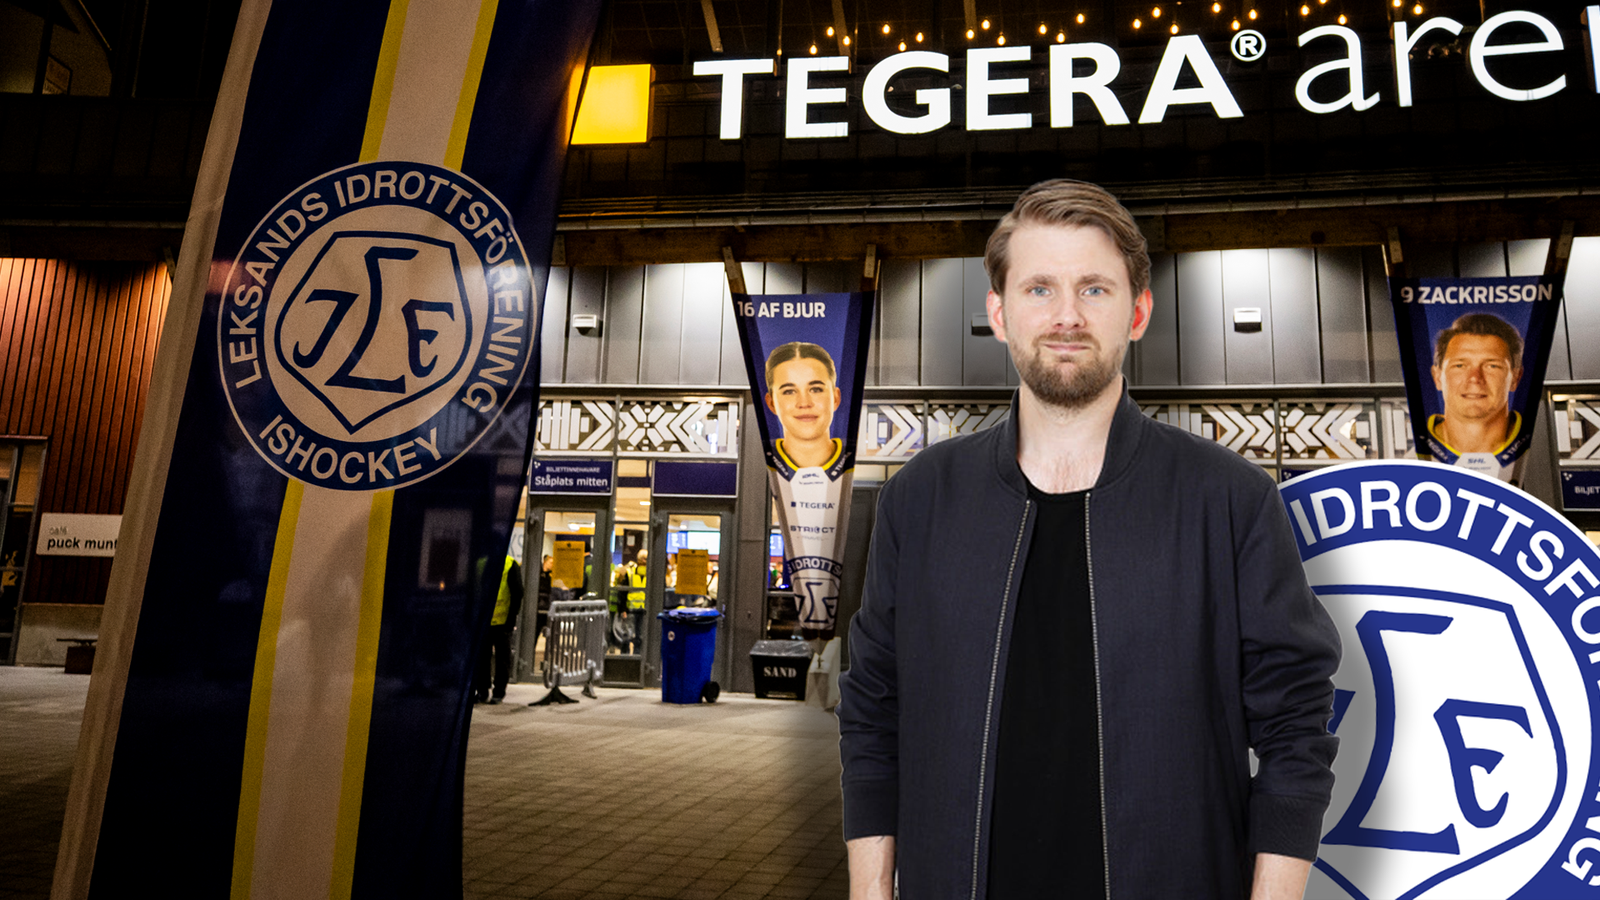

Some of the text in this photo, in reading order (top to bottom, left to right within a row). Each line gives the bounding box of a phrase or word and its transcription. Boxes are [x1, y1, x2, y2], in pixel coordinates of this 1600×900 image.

[229, 170, 524, 413] LEKSANDS IDROTTSFÖRENING
[1400, 284, 1553, 304] 9 ZACKRISSON
[737, 301, 826, 318] 16 AF BJUR
[259, 414, 442, 483] ISHOCKEY
[535, 474, 608, 487] Ståplats mitten
[47, 538, 80, 551] puck
[763, 666, 797, 678] SAND
